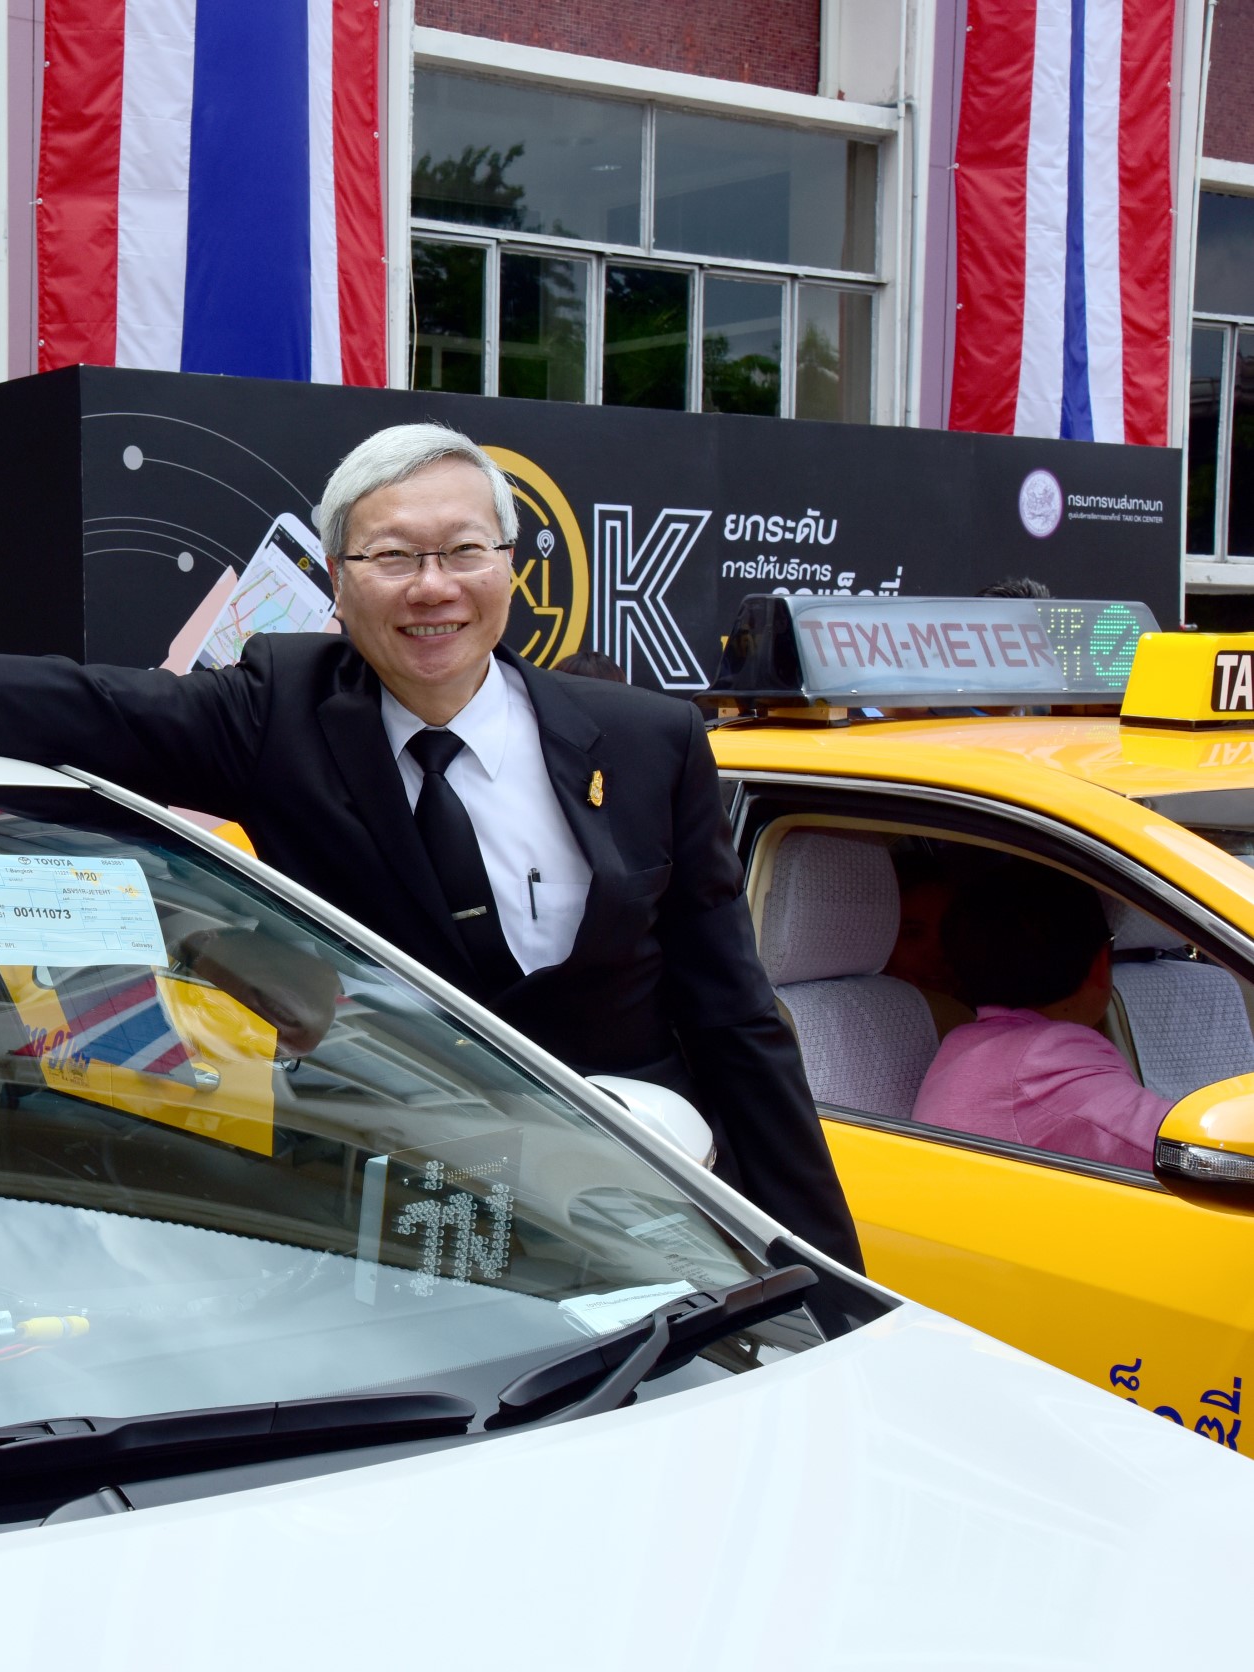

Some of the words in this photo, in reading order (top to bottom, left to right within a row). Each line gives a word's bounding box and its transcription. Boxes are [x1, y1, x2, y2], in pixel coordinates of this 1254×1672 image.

[1068, 494, 1163, 511] กรมการขนส่งทางบก
[723, 508, 838, 545] ยกระดับ
[722, 555, 832, 581] การให้บริการ
[799, 621, 1056, 668] TAXI-METER
[34, 857, 74, 867] TOYOTA
[75, 871, 98, 882] M20
[13, 906, 72, 920] 00111073
